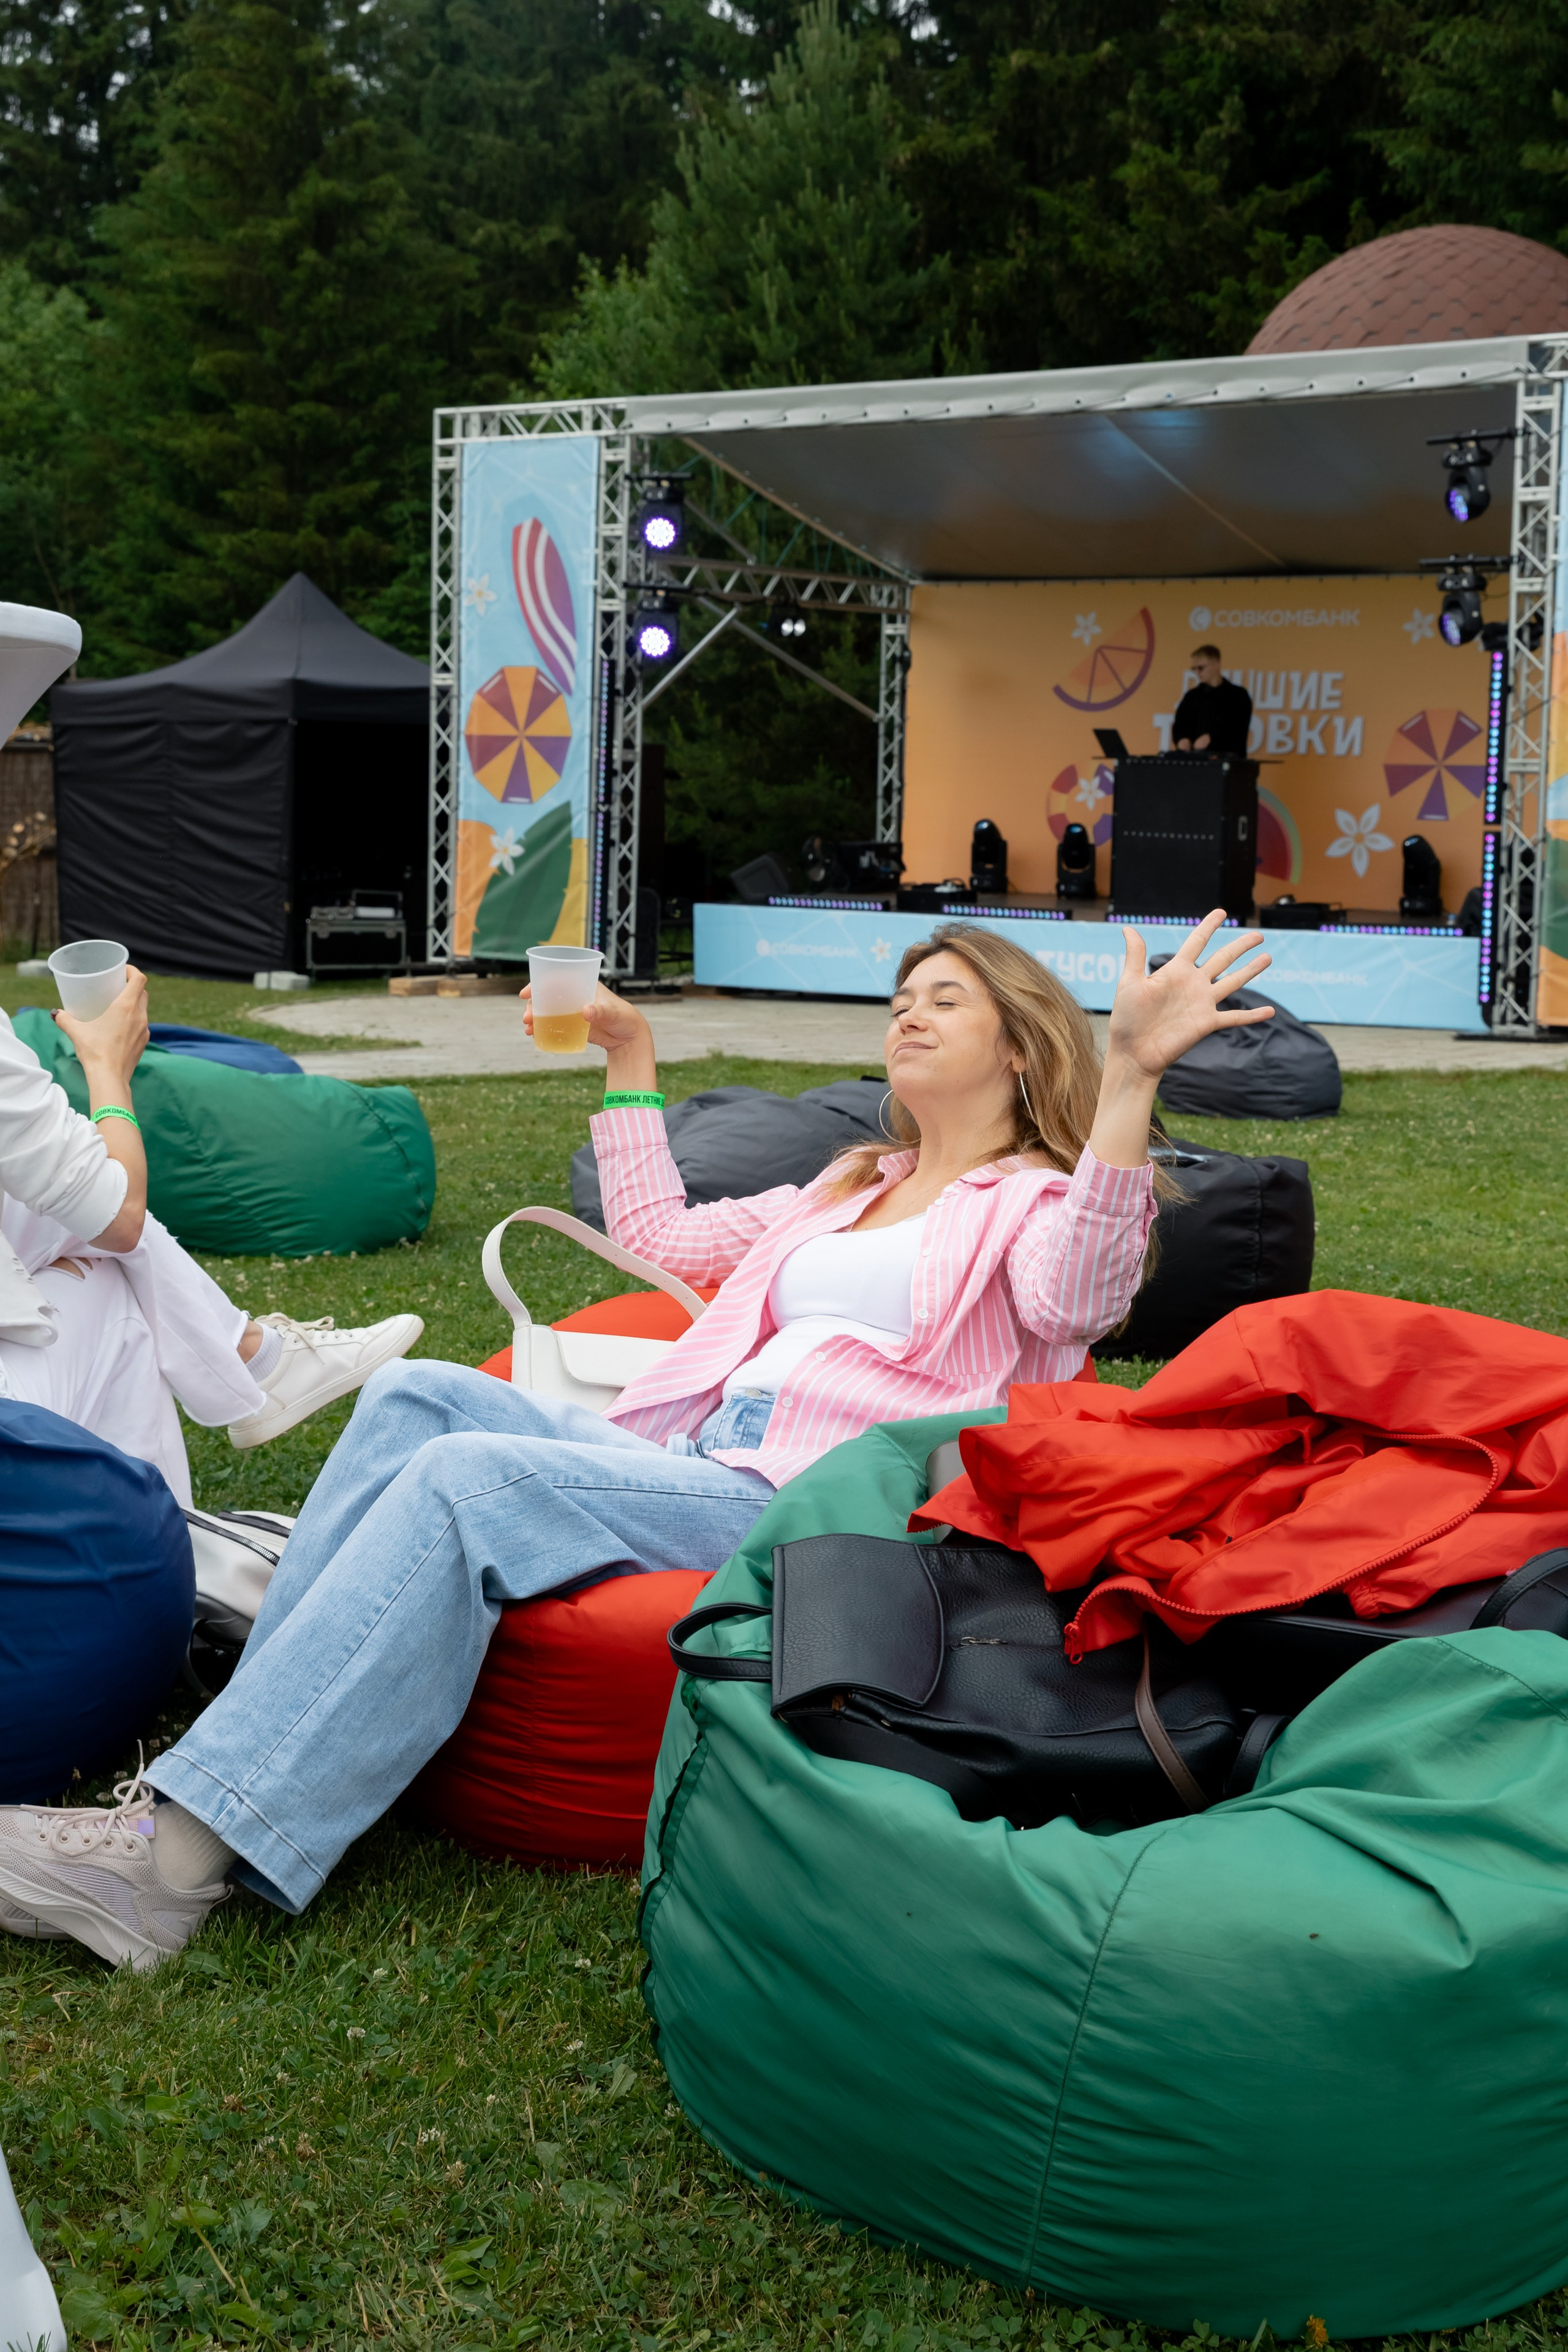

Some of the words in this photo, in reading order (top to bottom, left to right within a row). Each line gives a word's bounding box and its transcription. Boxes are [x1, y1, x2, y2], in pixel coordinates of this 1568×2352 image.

[1214, 609, 1360, 628] СОВКОМБАНК
[1174, 669, 1344, 711] ШИЕ
[1153, 712, 1365, 757] ТОВКИ
[1035, 950, 1126, 984] ТУСО
[605, 1095, 641, 1105] СОВКОМБАНК
[642, 1095, 661, 1106] ЛЕТНИЕ
[95, 1107, 137, 1123] СОВКОМБАНК
